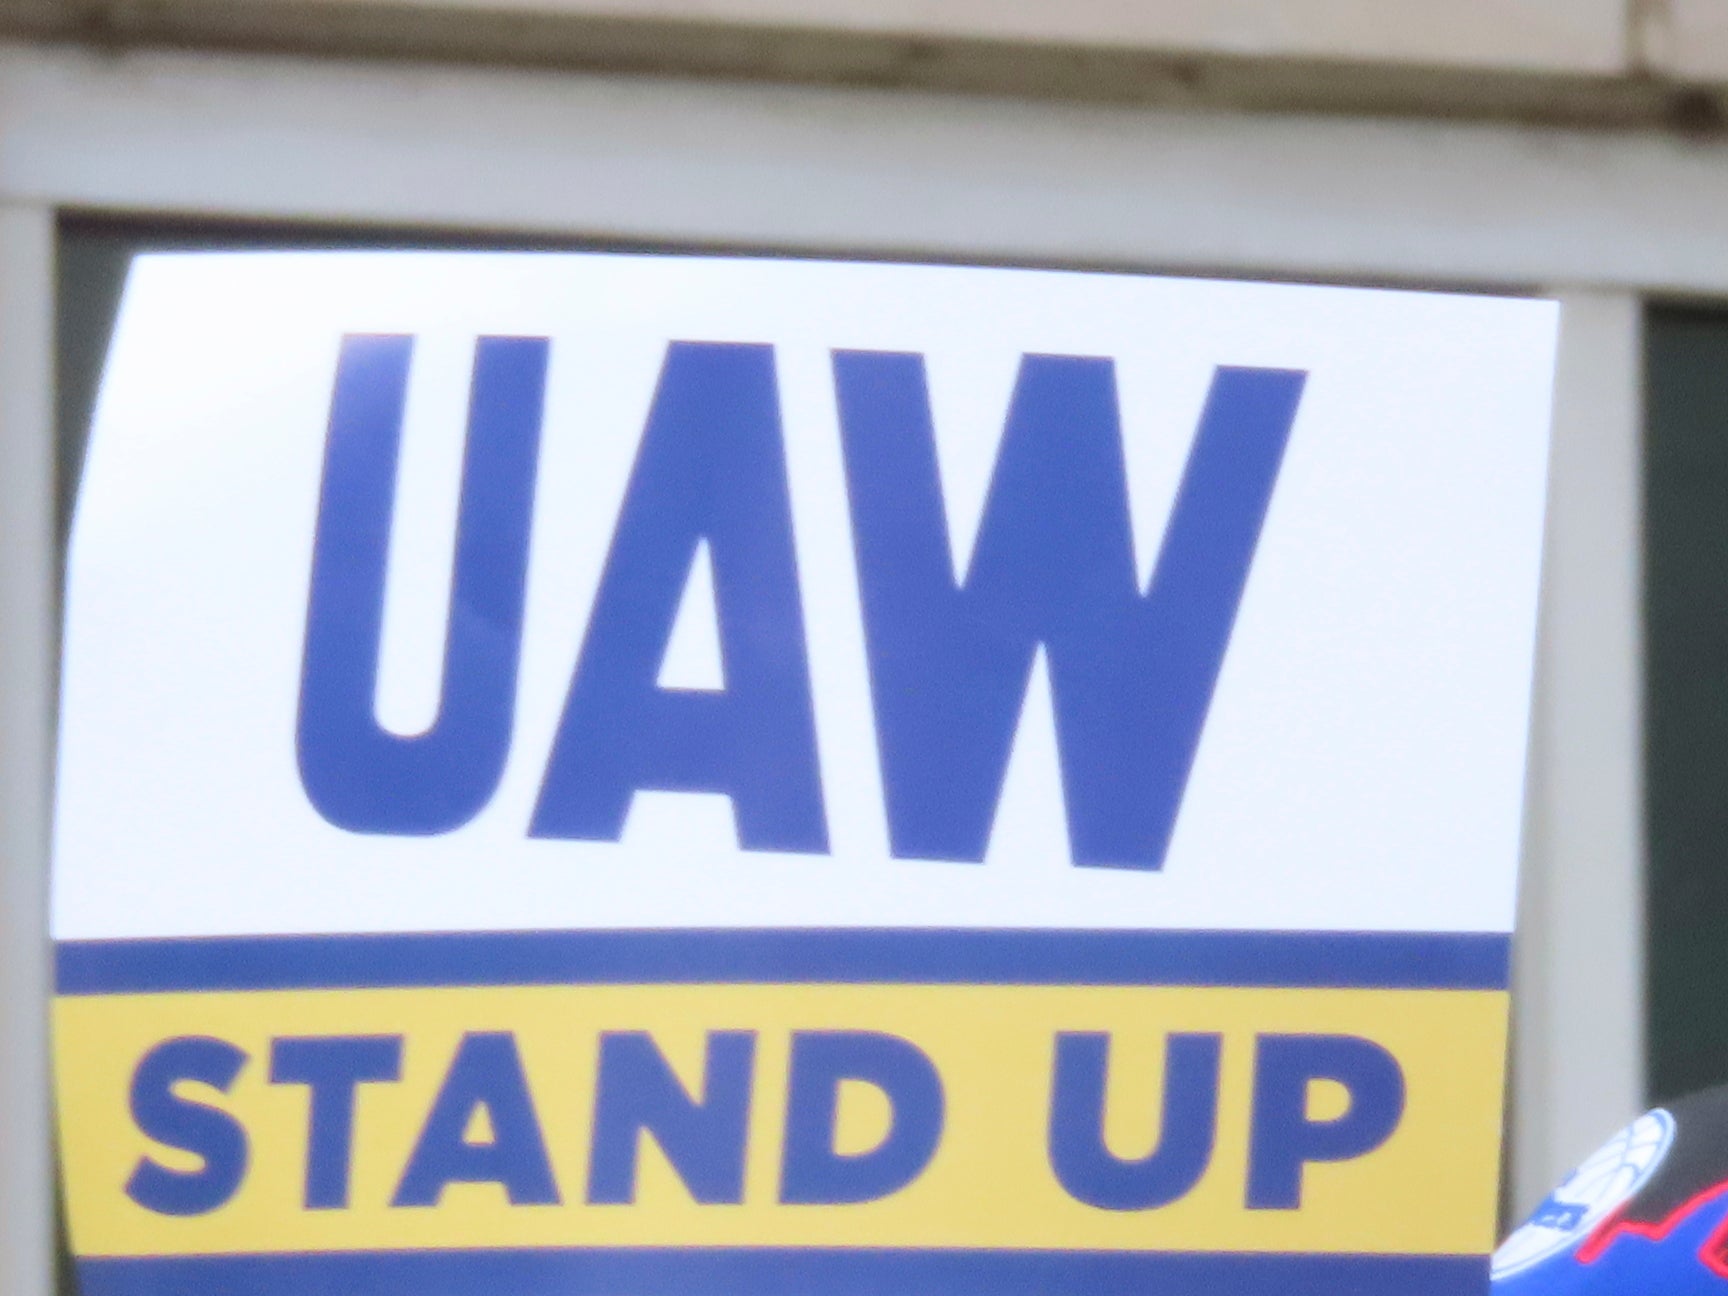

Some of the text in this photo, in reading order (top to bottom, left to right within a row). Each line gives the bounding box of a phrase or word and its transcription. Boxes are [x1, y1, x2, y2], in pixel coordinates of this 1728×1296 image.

[294, 332, 1309, 873] UAW
[122, 1029, 1408, 1216] STAND UP
